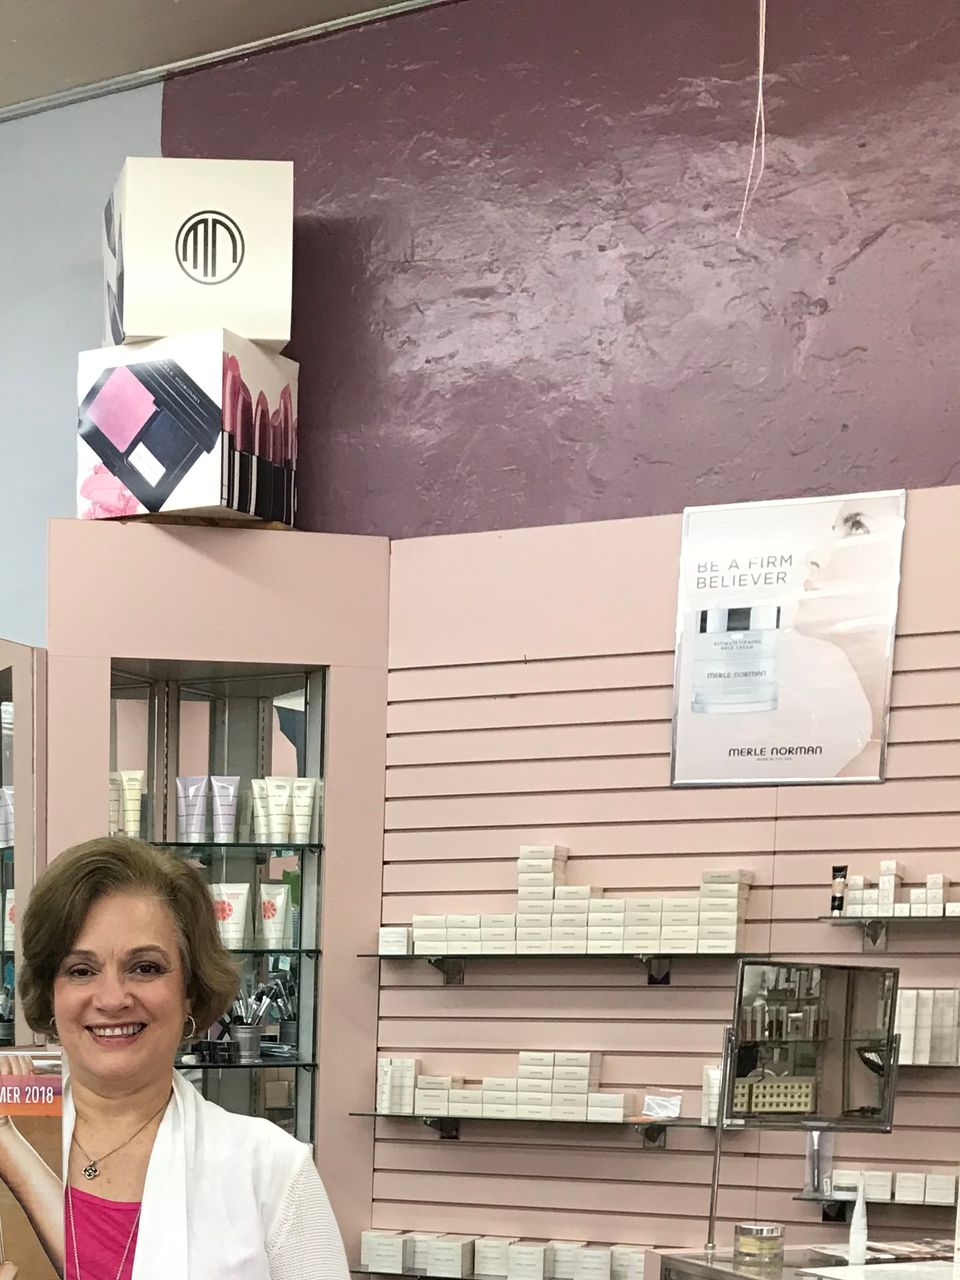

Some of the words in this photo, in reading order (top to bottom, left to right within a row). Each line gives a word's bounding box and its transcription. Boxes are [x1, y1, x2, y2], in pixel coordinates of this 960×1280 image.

[697, 560, 720, 574] BE
[727, 558, 740, 571] A
[748, 553, 793, 570] FIRM
[696, 571, 788, 590] BELIEVER
[728, 747, 768, 758] MERLE
[770, 745, 824, 756] NORMAN
[24, 1086, 54, 1104] 2018
